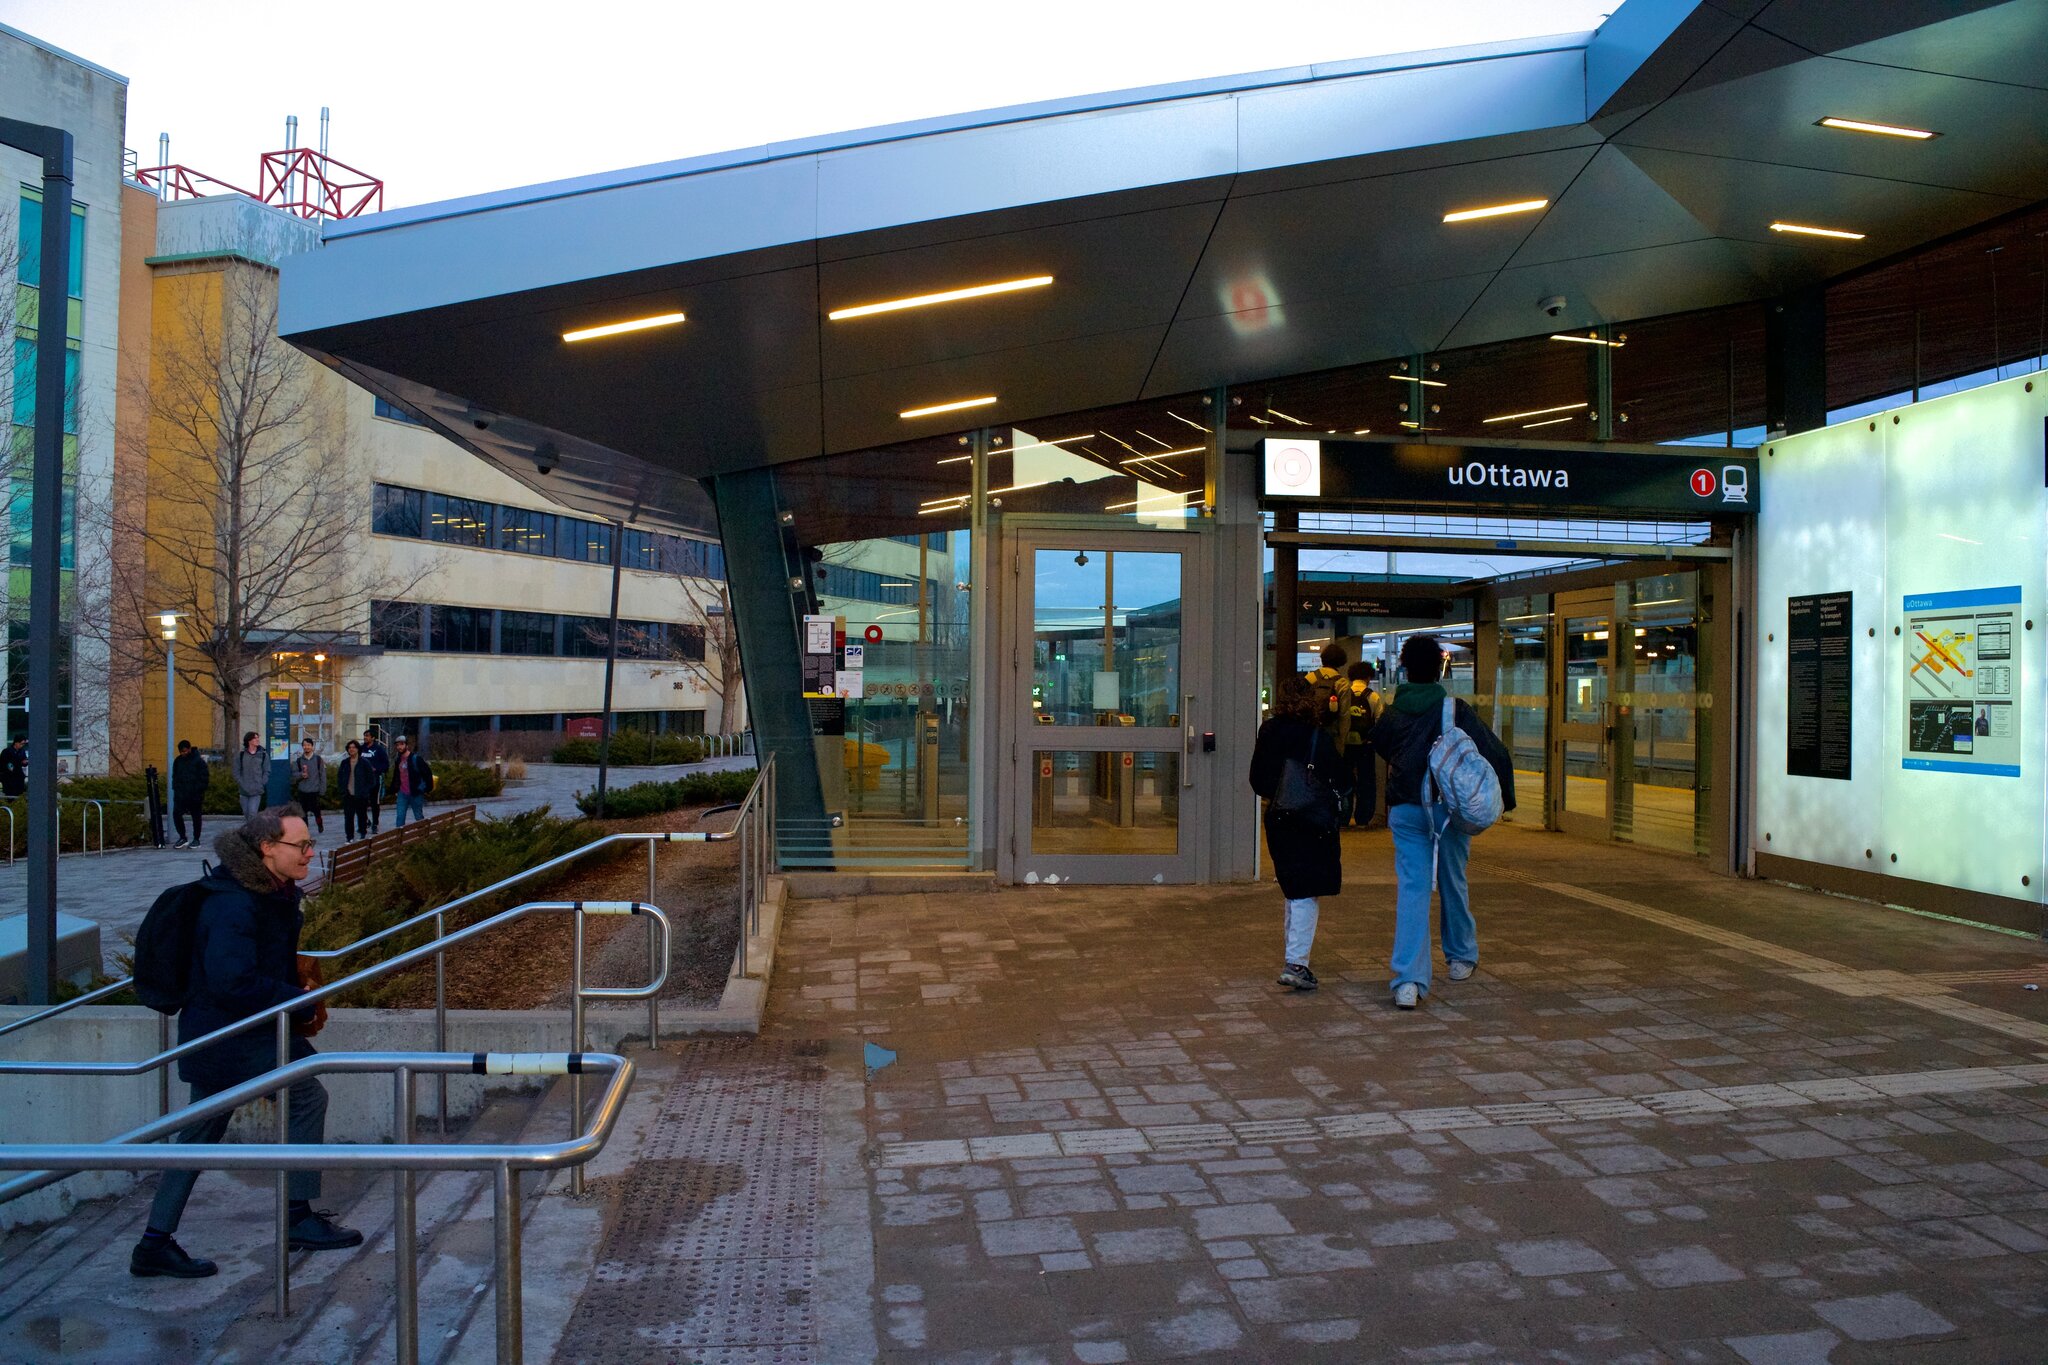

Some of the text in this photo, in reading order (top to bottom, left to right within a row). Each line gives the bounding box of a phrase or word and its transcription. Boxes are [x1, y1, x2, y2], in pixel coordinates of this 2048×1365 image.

[1448, 461, 1569, 488] uOttawa
[1697, 473, 1707, 492] 1
[1906, 599, 1933, 608] uOttawa
